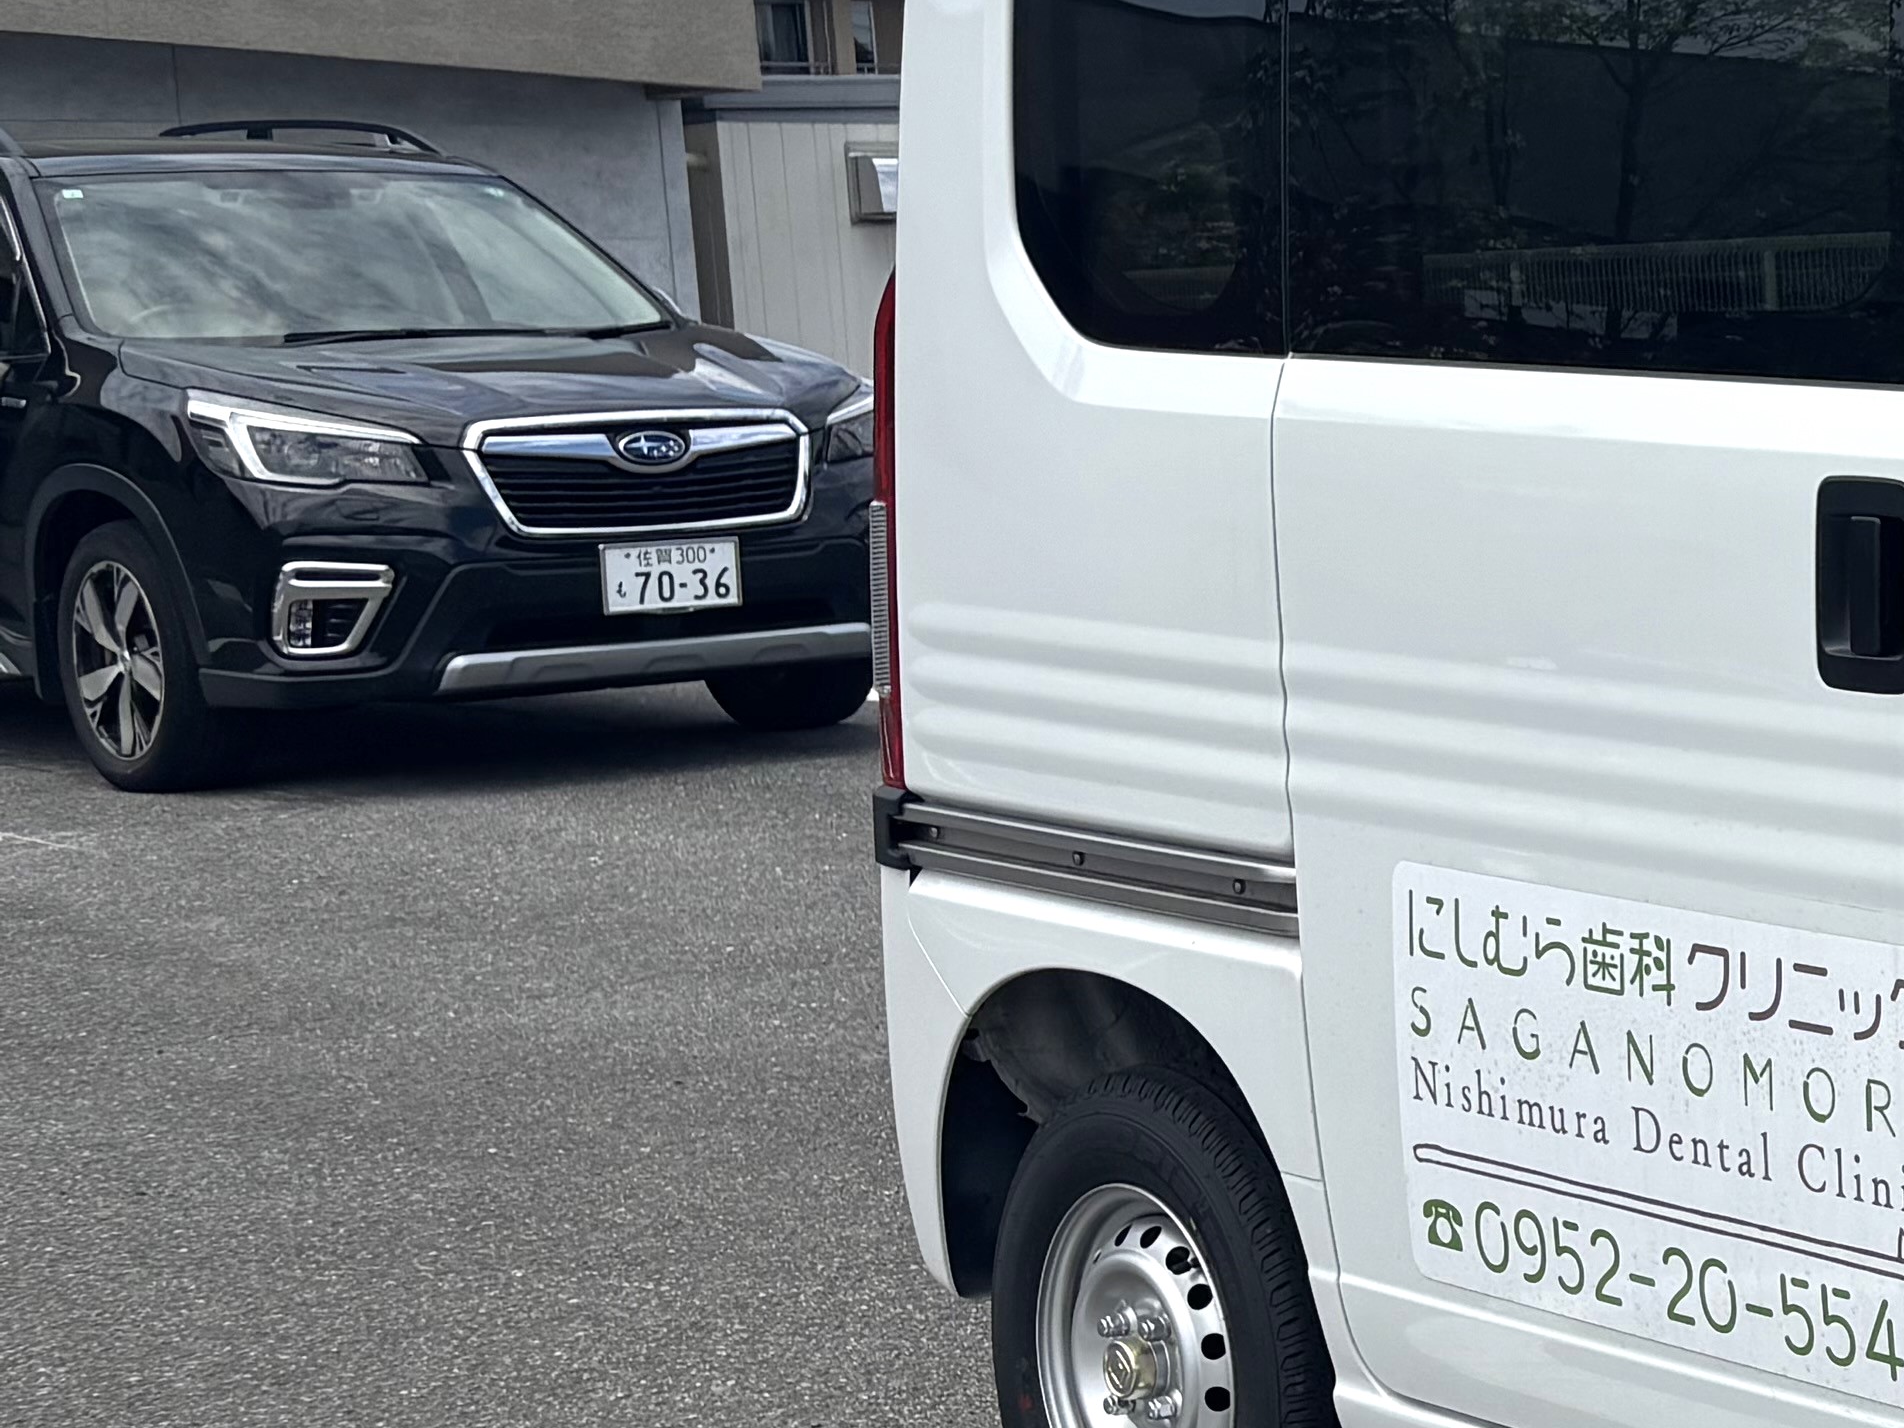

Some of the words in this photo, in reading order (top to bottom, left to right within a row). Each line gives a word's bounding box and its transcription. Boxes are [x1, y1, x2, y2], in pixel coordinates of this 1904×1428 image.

[634, 566, 731, 605] 70-36
[1410, 1056, 1610, 1145] Nishimura
[1631, 1106, 1773, 1182] Dental
